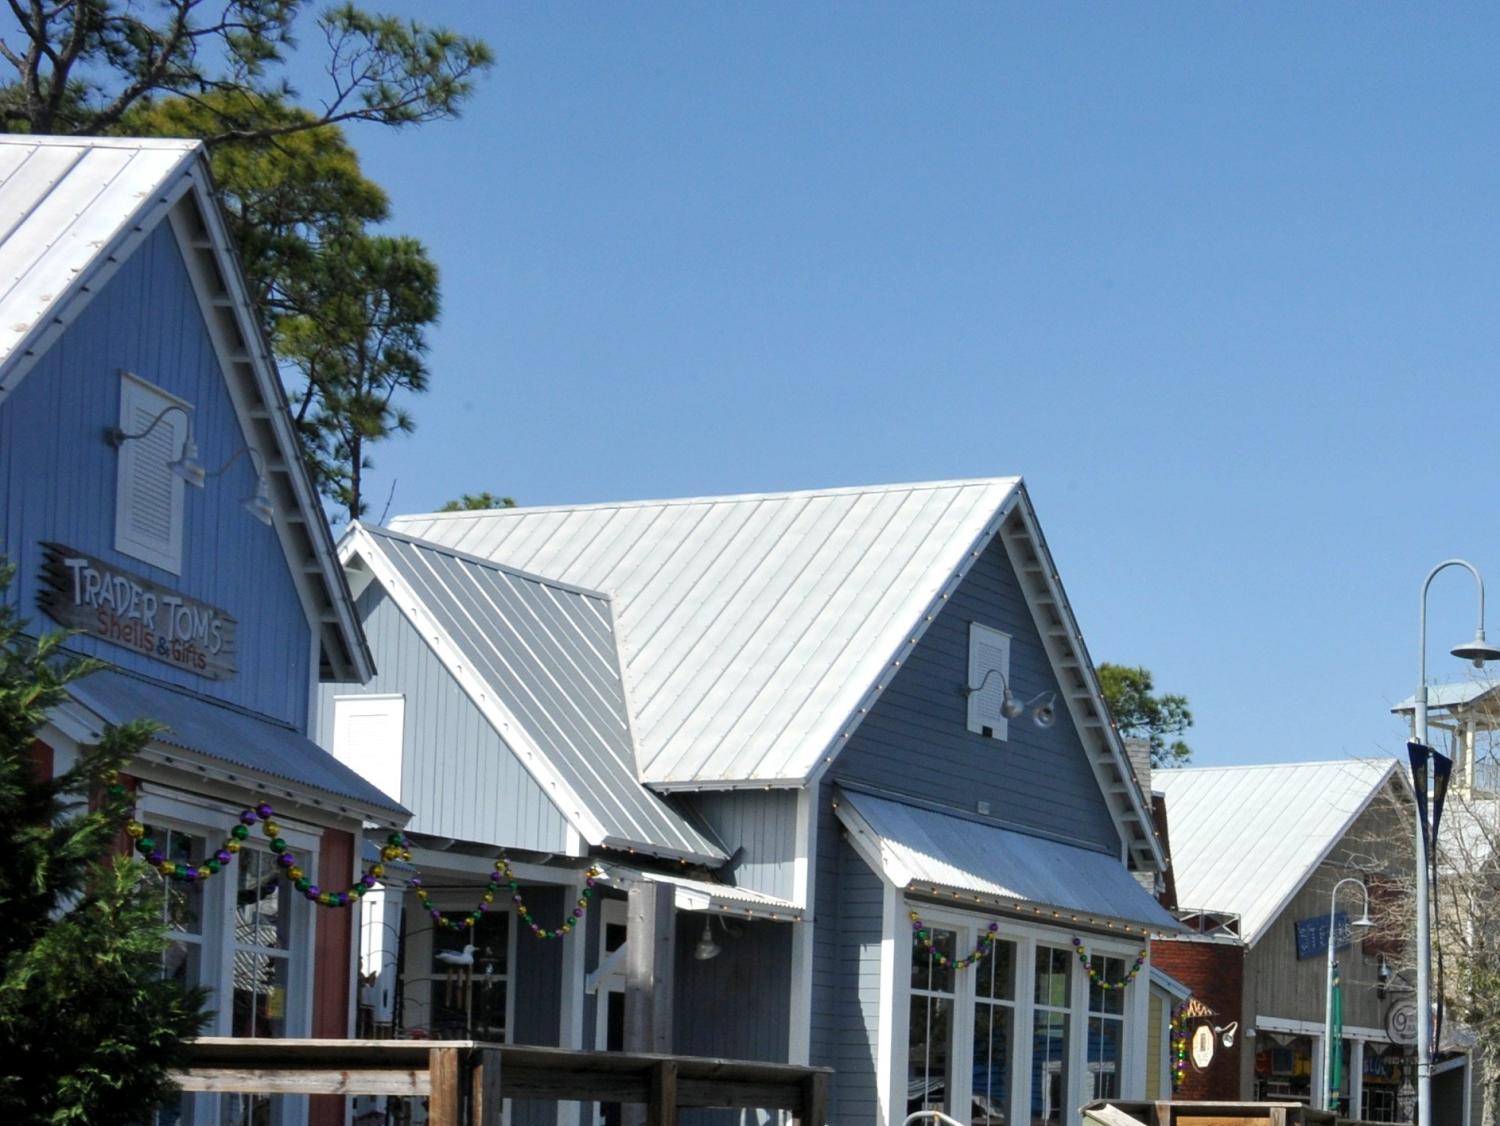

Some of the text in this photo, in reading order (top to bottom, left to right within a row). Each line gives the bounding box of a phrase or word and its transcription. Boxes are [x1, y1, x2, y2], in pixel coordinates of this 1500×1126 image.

[64, 558, 222, 656] TRADER TOM'S
[97, 608, 207, 670] Shells & Gifts
